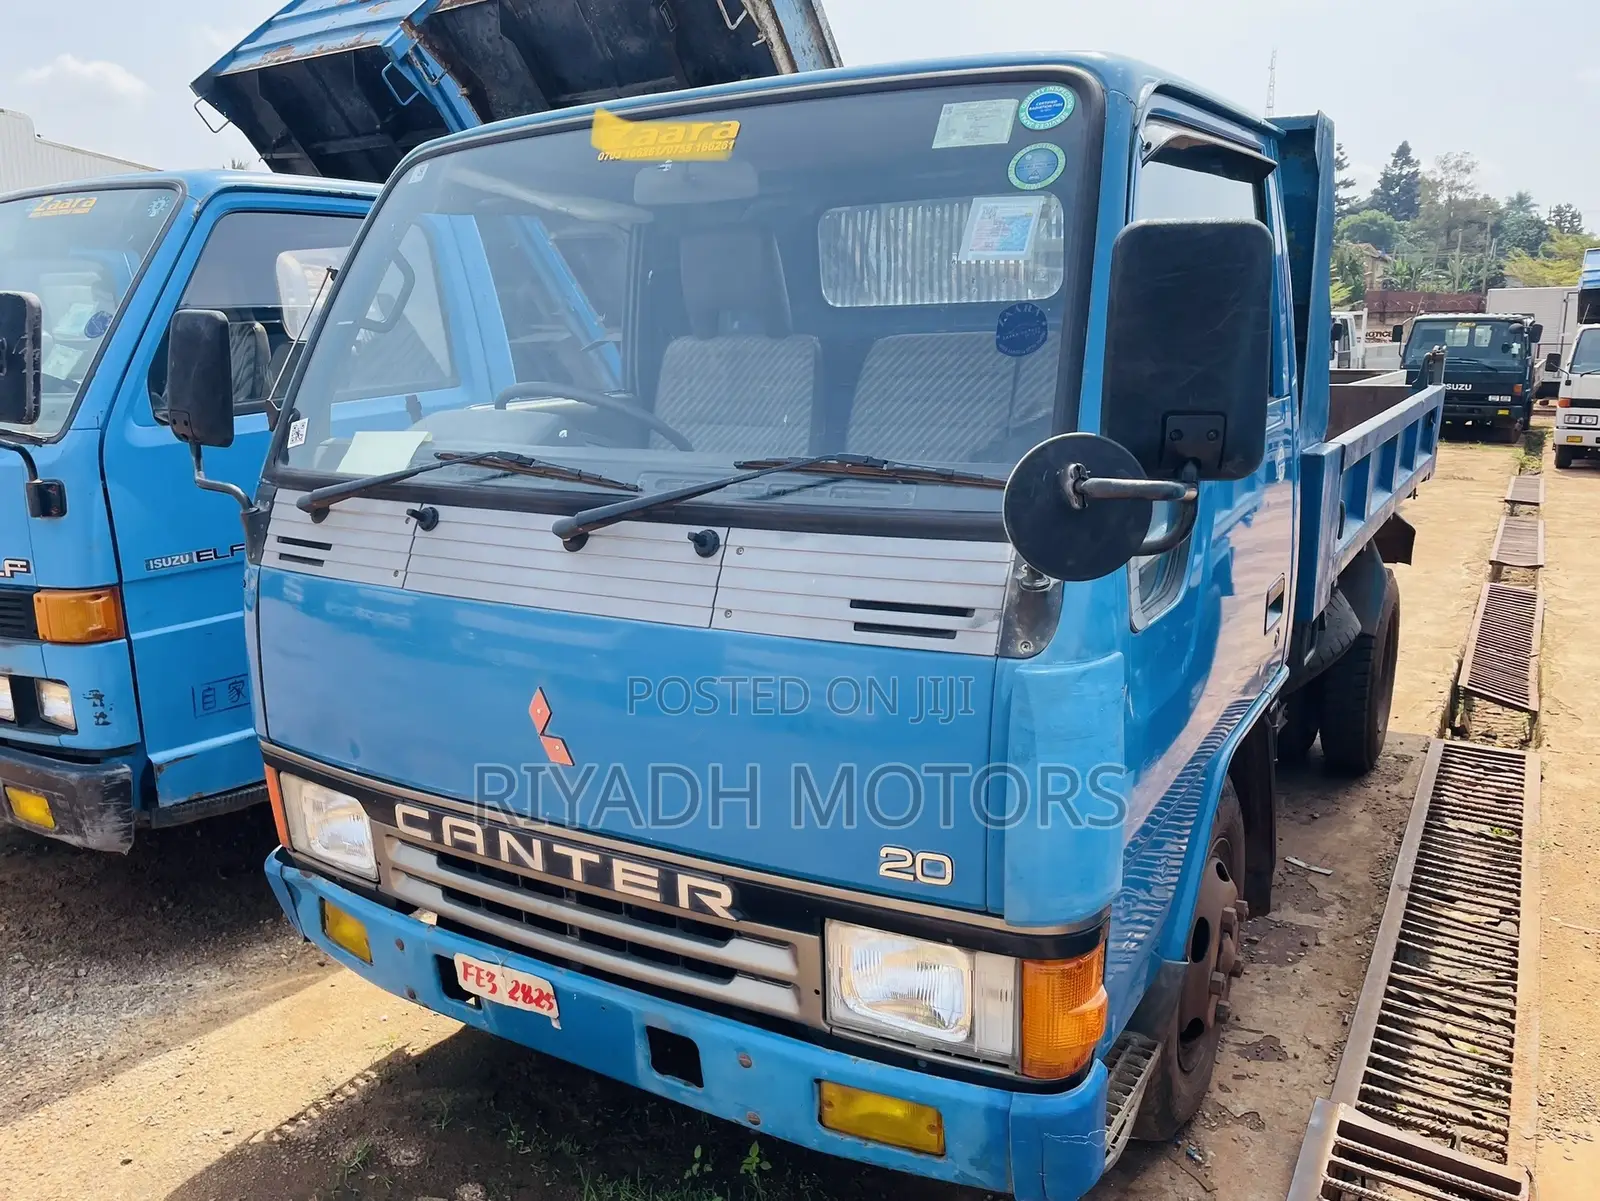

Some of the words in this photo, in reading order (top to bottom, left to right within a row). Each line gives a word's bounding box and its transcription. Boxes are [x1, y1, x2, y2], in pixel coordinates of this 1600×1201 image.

[35, 195, 97, 210] Zaara
[149, 554, 190, 569] ISUZU
[394, 803, 740, 921] CANTER
[879, 845, 955, 887] 20
[462, 961, 498, 995] FE3
